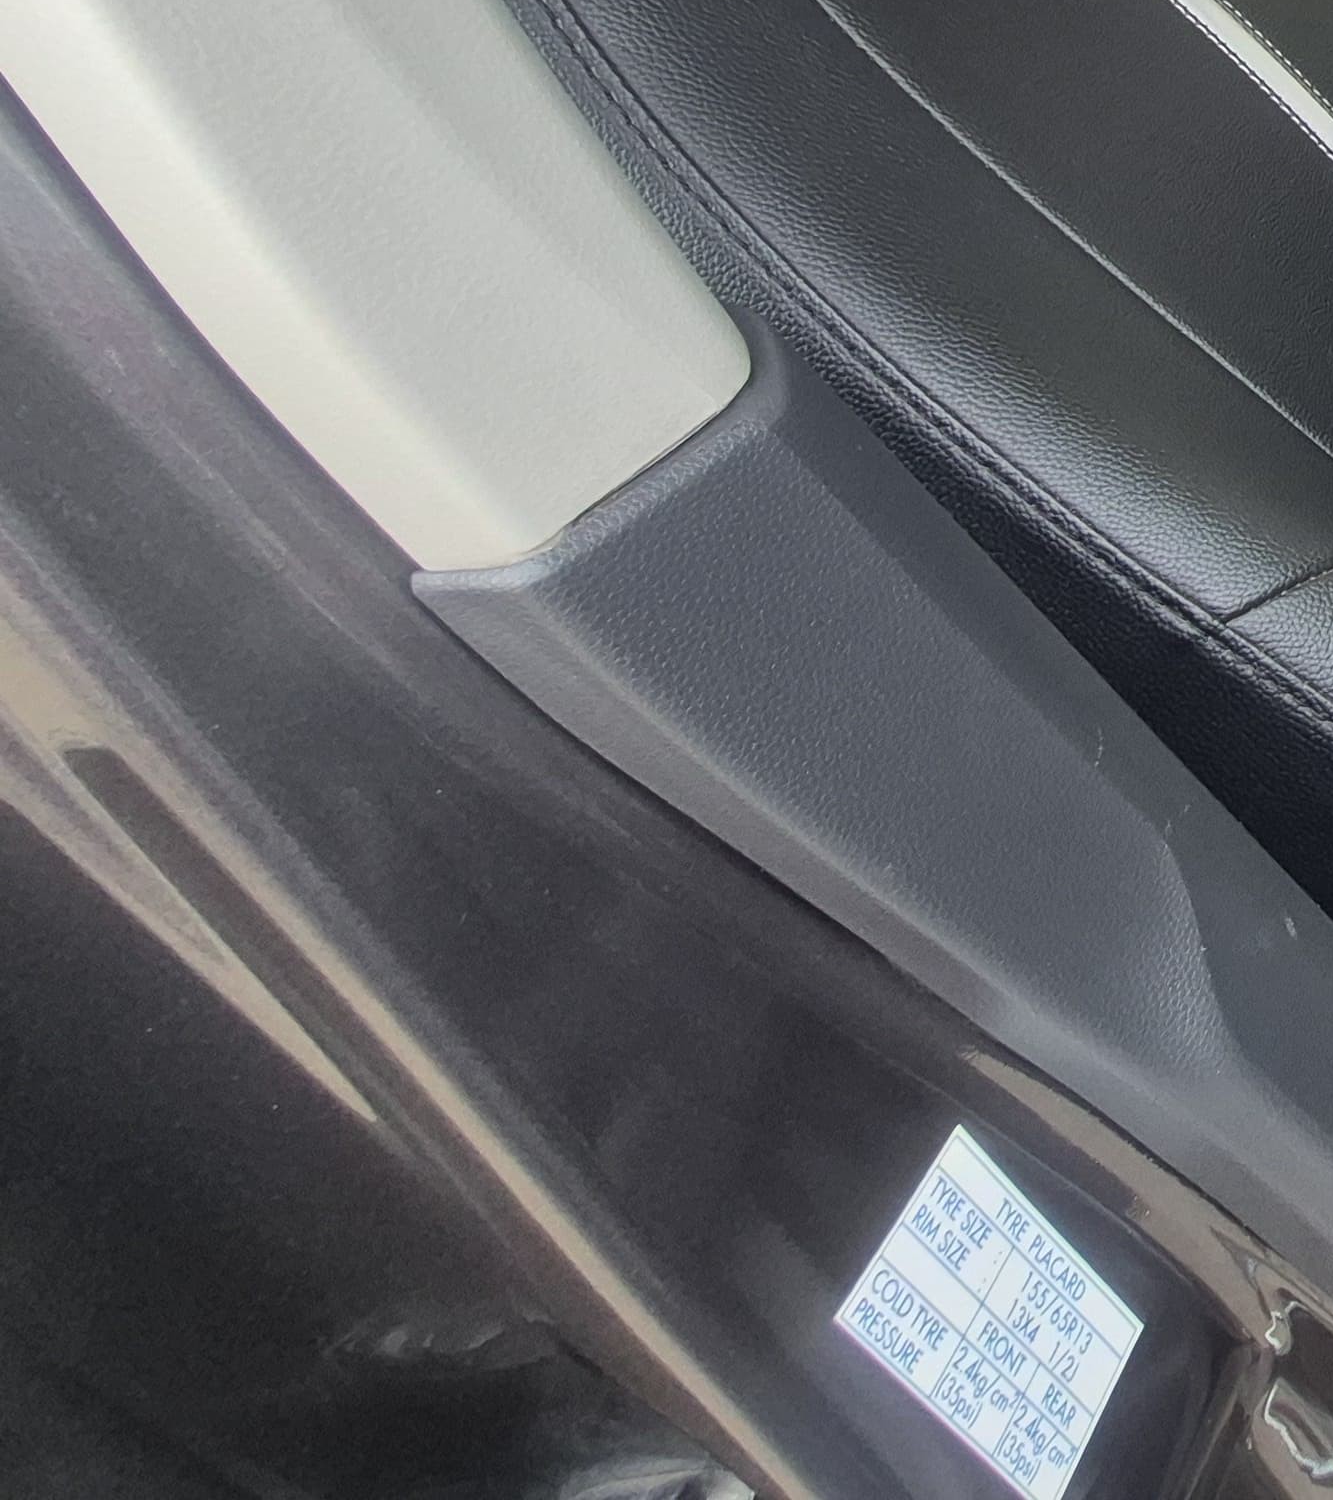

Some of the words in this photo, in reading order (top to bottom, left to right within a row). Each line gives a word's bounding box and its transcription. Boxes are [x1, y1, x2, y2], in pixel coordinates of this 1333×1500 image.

[871, 1268, 914, 1318] COLD
[910, 1303, 949, 1352] TYRE
[911, 1203, 941, 1243] RIM
[938, 1230, 970, 1272] SIZE
[1006, 1299, 1041, 1345] 13X4
[930, 1175, 964, 1222] TYRE
[960, 1209, 993, 1250] SIZE
[1020, 1270, 1094, 1356] 155/65R13
[996, 1196, 1030, 1242] TYRE
[1028, 1233, 1087, 1302] PLACARD
[850, 1296, 924, 1375] PRESSURE
[934, 1371, 984, 1430] (35psi)
[996, 1429, 1043, 1487] (35psi)
[977, 1319, 1028, 1378] FRONT
[1041, 1382, 1078, 1432] REAR
